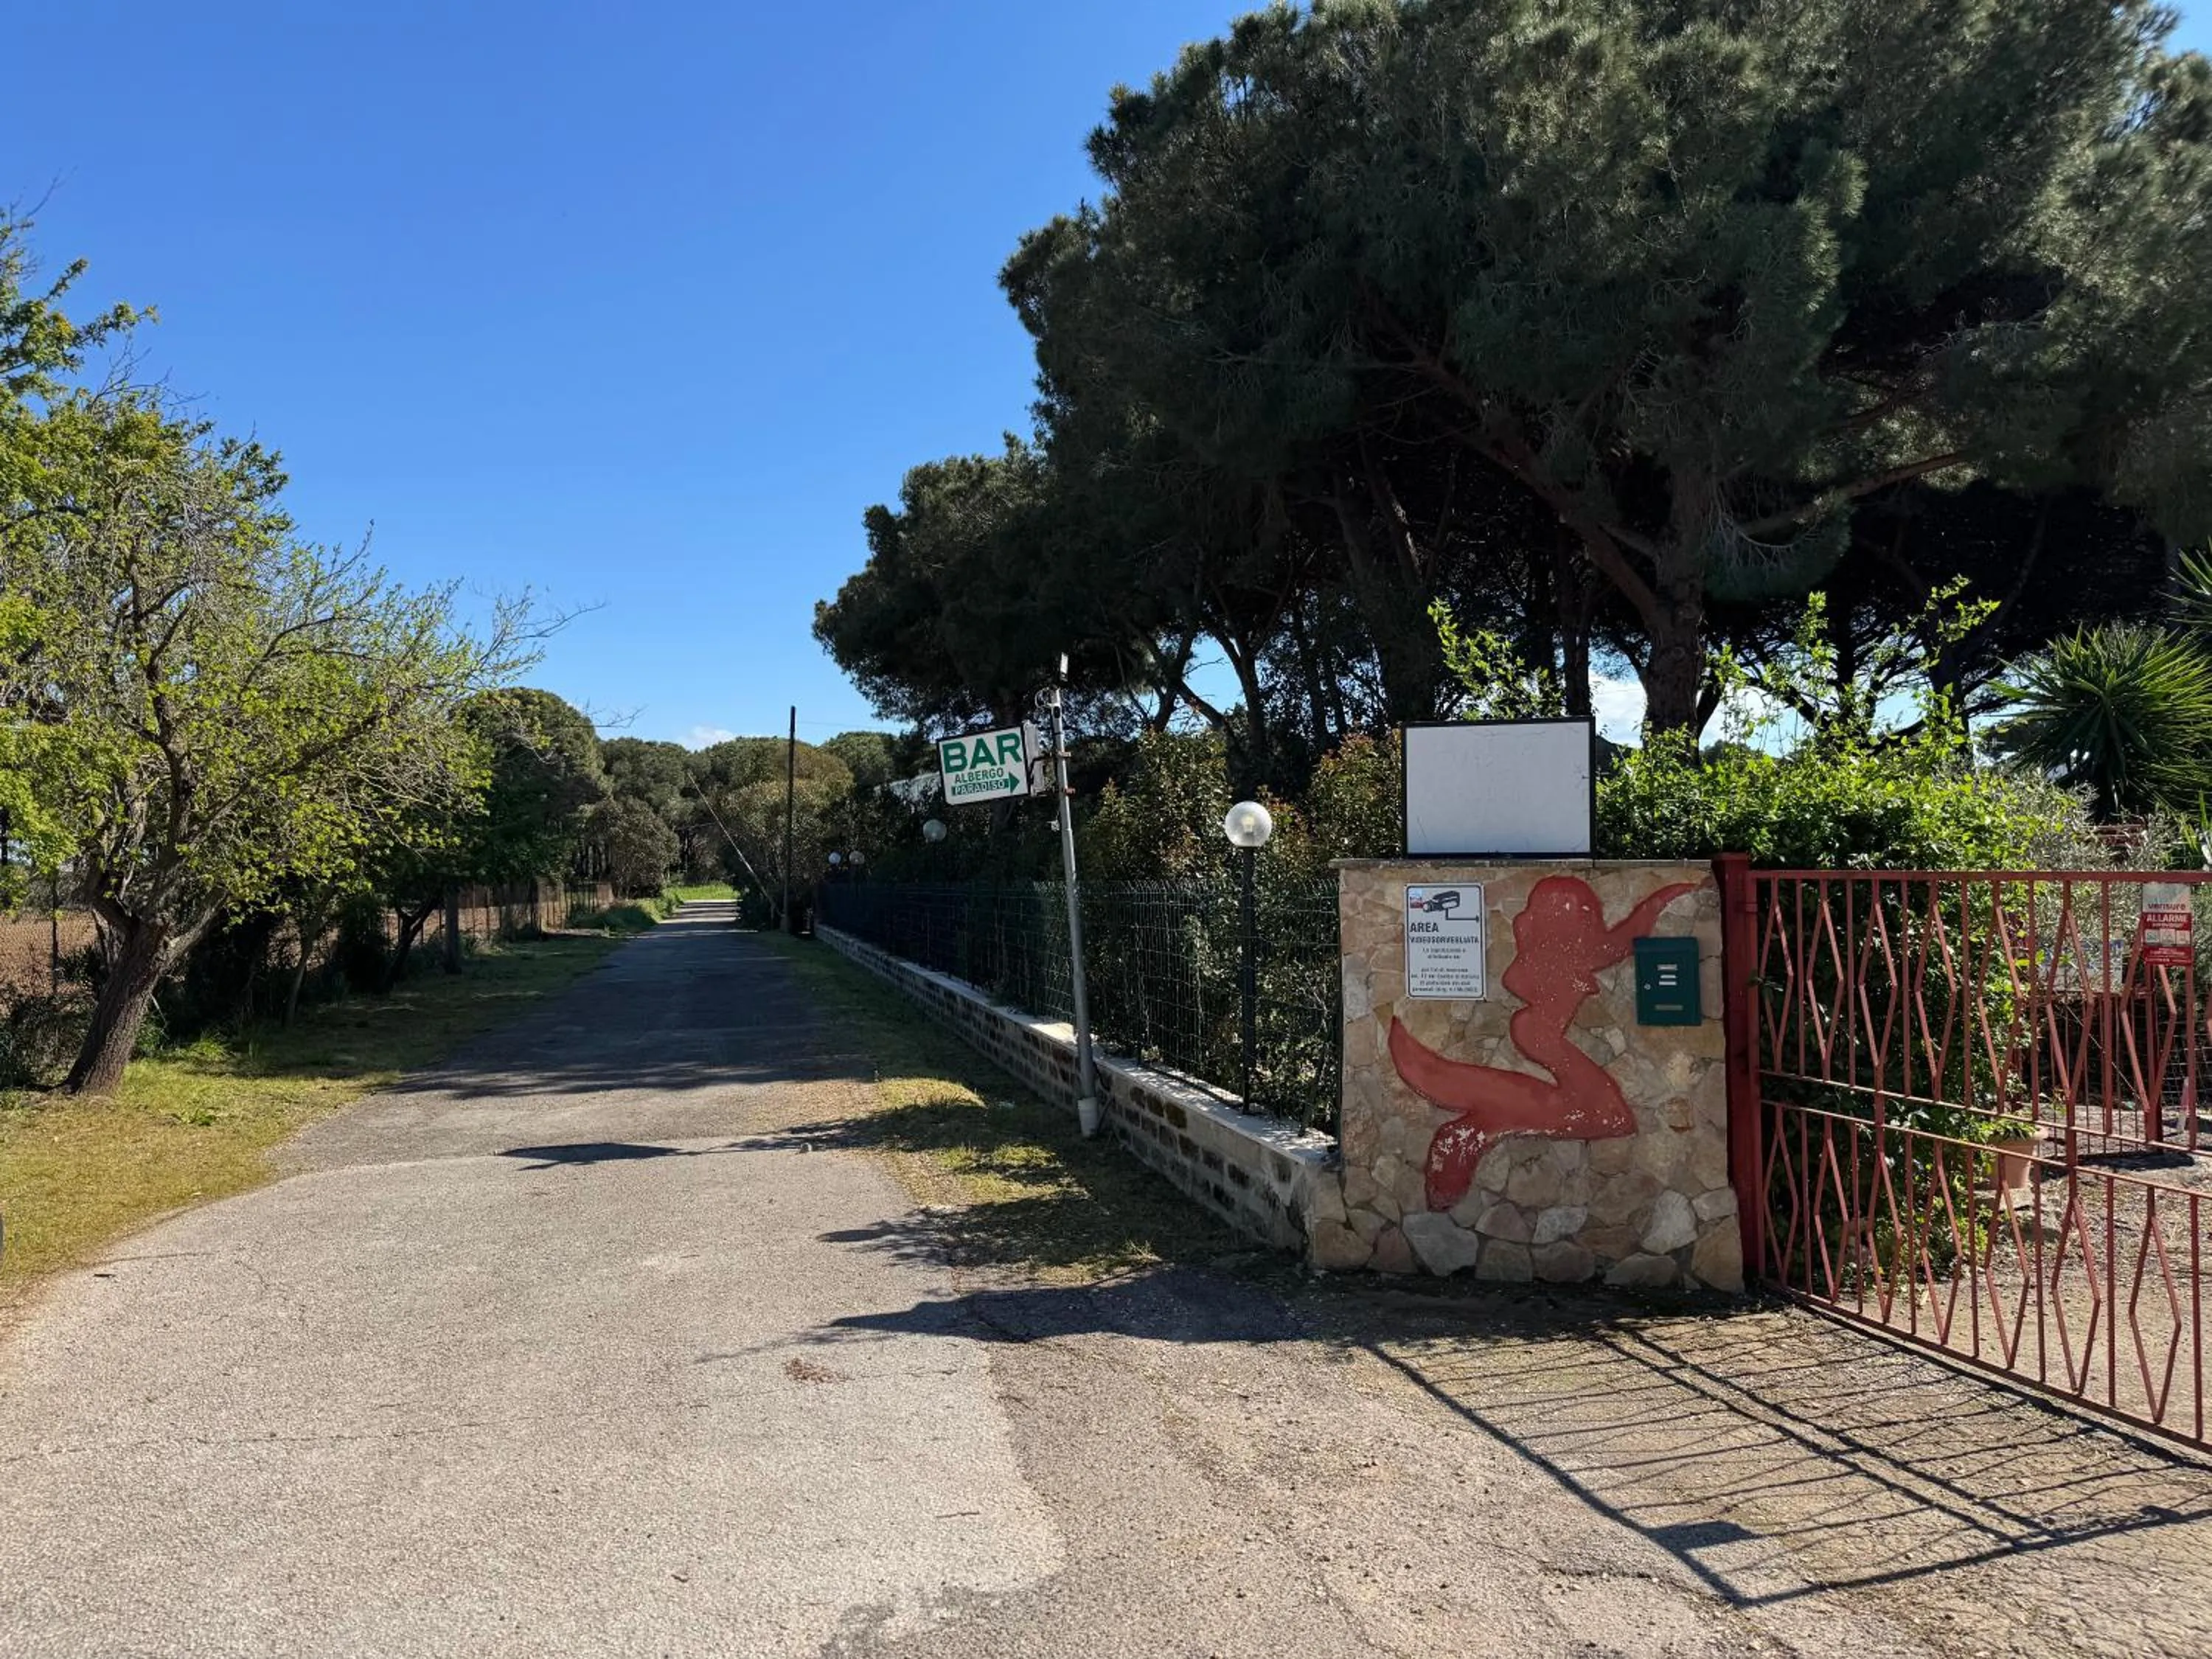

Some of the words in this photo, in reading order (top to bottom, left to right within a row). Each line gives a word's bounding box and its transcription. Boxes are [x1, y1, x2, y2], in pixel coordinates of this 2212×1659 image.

[942, 733, 1022, 774] BAR
[955, 768, 1004, 784] ALBERGO
[955, 780, 1005, 795] PARADISO
[2146, 914, 2188, 922] ALLARME
[1410, 922, 1439, 933] AREA
[1410, 936, 1479, 944] VIDEOSORVEGLIATA
